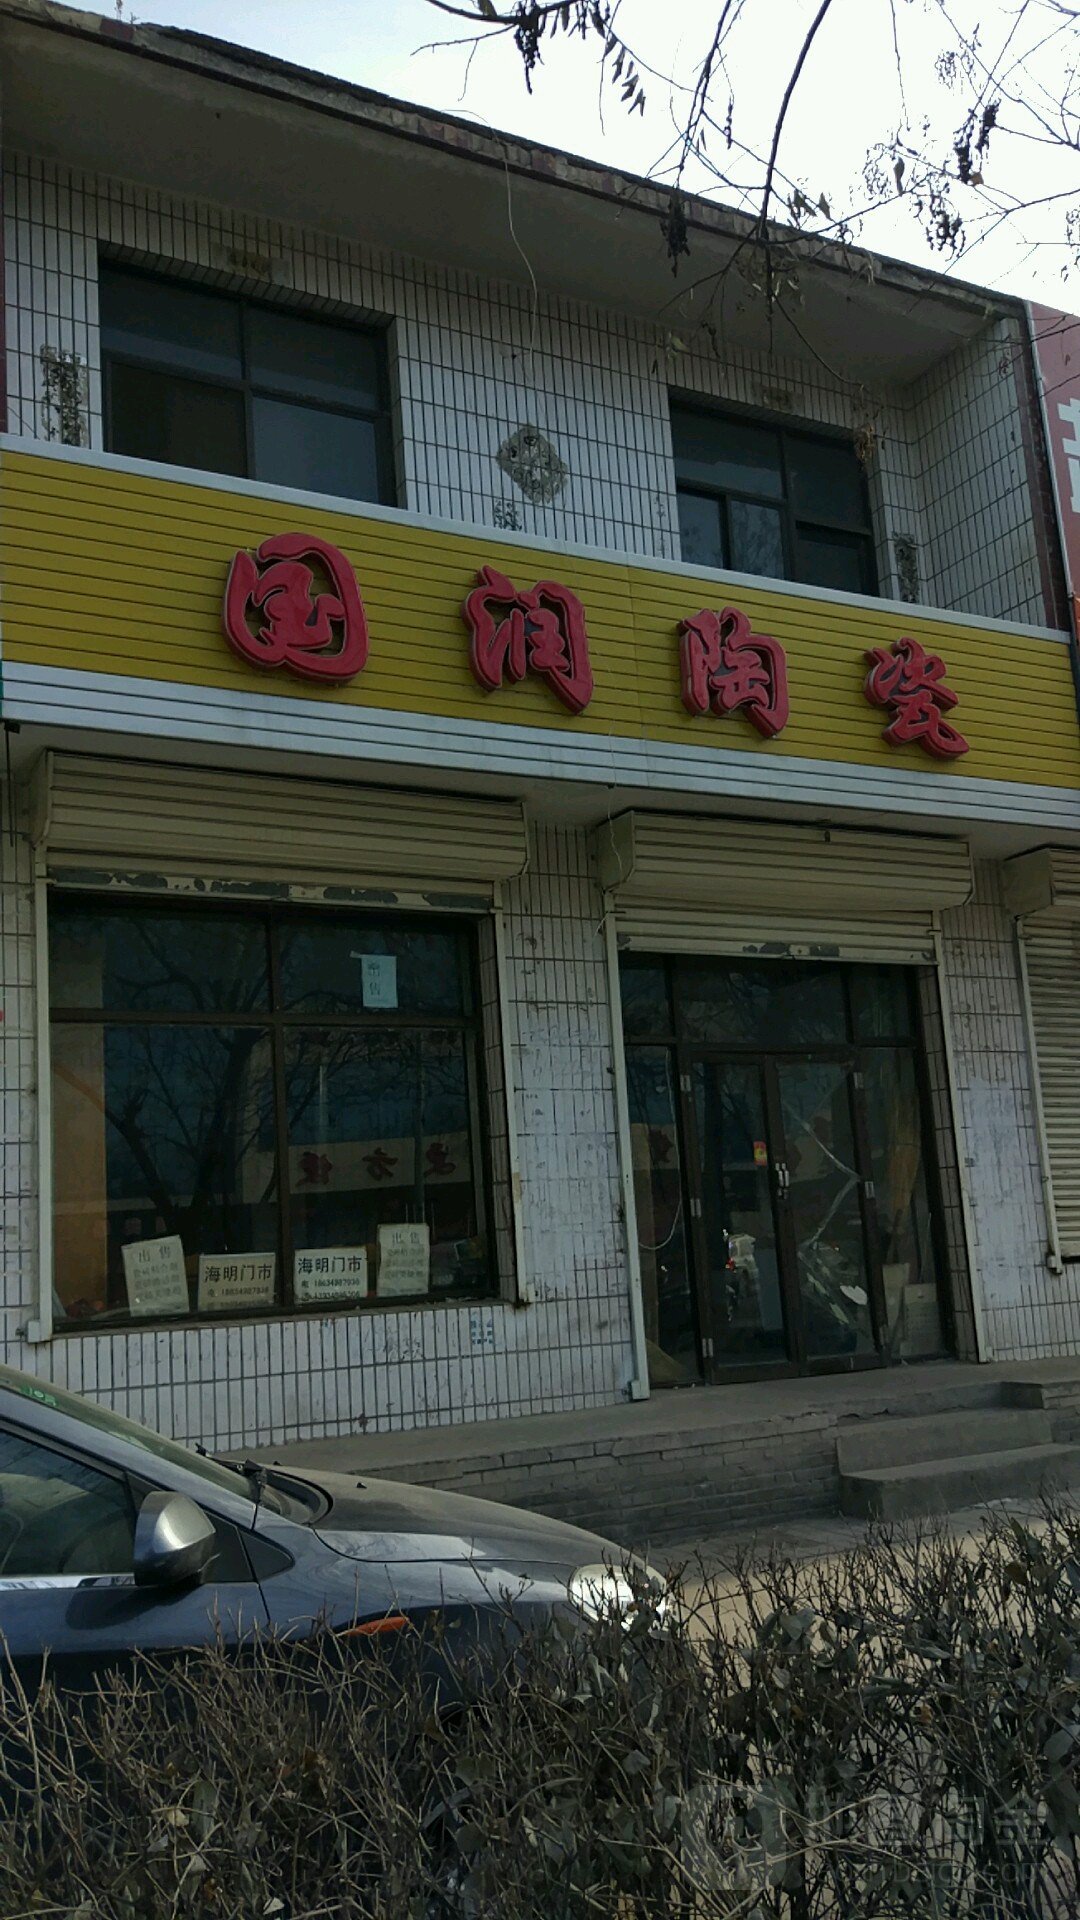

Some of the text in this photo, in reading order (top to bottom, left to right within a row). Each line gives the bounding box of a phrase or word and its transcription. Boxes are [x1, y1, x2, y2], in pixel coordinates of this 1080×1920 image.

[221, 532, 970, 760] 国润陶瓷
[204, 1263, 273, 1283] 海明门市
[298, 1255, 362, 1275] 海明门市
